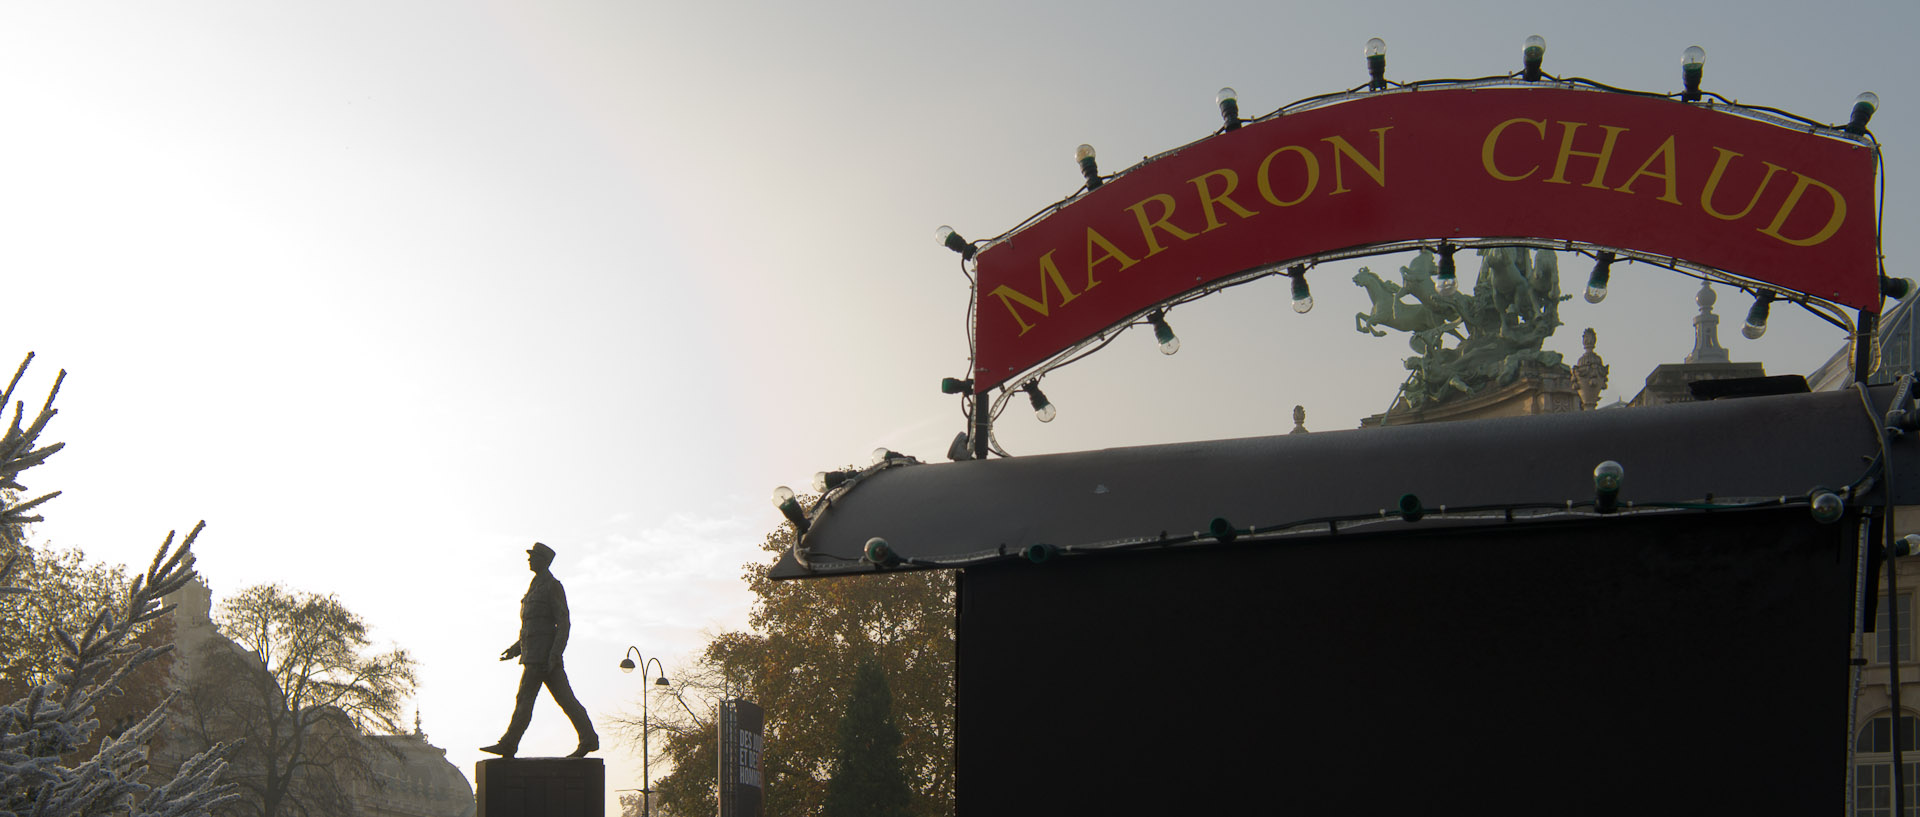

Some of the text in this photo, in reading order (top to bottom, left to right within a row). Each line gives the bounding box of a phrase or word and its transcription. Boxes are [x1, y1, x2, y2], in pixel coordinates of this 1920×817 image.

[987, 117, 1848, 337] MARRON CHAUD
[739, 728, 752, 750] DES
[739, 748, 748, 767] ET
